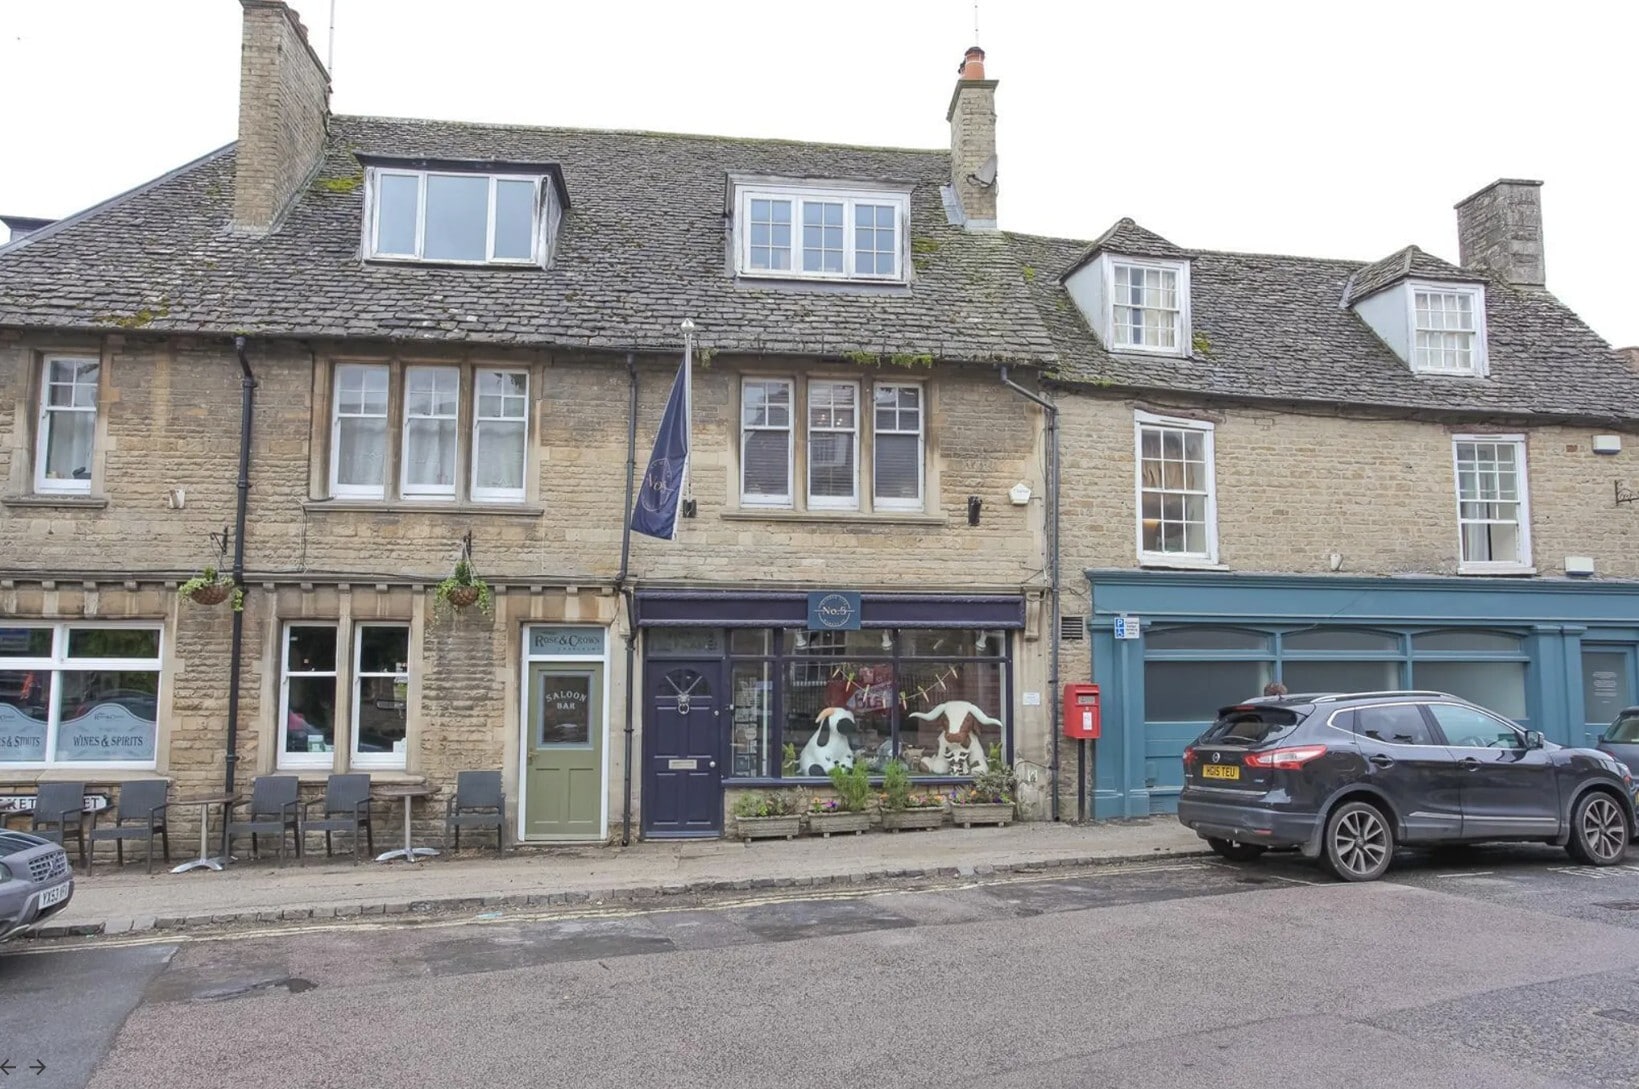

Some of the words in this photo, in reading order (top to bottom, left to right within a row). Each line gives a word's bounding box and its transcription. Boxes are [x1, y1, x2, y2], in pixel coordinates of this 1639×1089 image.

[545, 690, 587, 702] SALOON
[556, 702, 576, 710] BAR
[73, 734, 100, 747] WINES
[101, 734, 109, 747] &
[111, 735, 144, 747] SPIRITS
